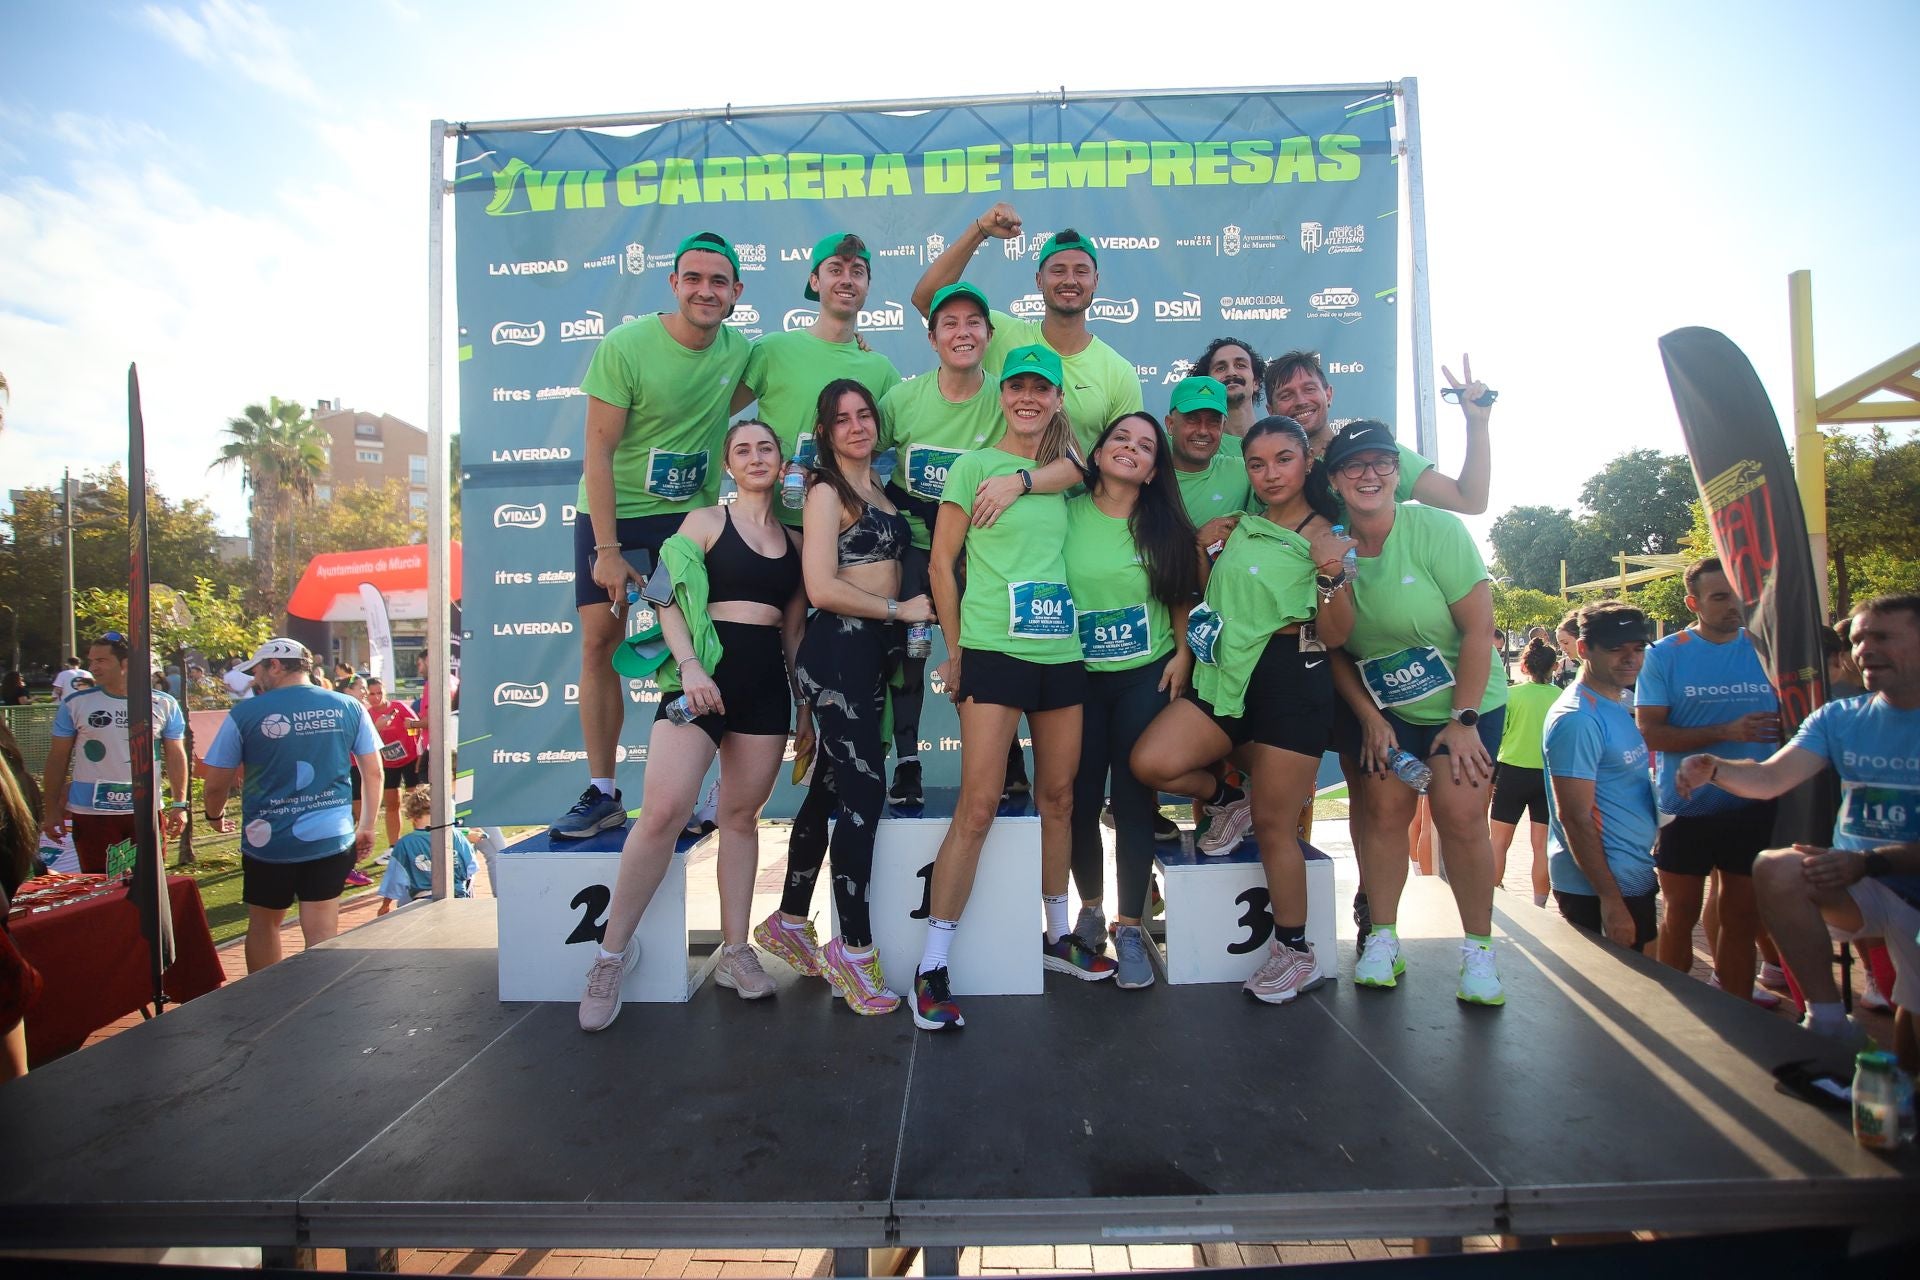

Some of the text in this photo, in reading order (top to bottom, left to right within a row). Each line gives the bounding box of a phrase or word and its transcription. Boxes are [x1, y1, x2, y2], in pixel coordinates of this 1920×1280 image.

[522, 134, 1361, 212] VII CARRERA DE EMPRESAS
[1100, 238, 1160, 249] VERDAD
[1323, 236, 1365, 245] ATLETISMO
[780, 248, 801, 261] LA
[490, 260, 568, 276] LA VERDAD
[1256, 296, 1286, 305] GLOBAL
[1094, 305, 1132, 316] VIDAL
[1154, 301, 1201, 317] DSM
[856, 310, 904, 327] DSM
[500, 328, 538, 340] VIDAL
[560, 319, 604, 338] DSM
[1329, 362, 1365, 374] Hero
[493, 388, 531, 402] itres
[492, 448, 571, 462] LA VERDAD
[667, 467, 697, 482] 814
[924, 465, 948, 482] 80
[501, 510, 540, 522] VIDAL
[316, 557, 422, 578] Ayuntamiento de Murcia
[495, 570, 576, 585] itres atalay
[1031, 600, 1062, 616] 804
[494, 622, 573, 636] LA VERDAD
[1095, 624, 1132, 642] 812
[1382, 661, 1425, 687] 806
[501, 689, 542, 700] VIDAL
[1683, 682, 1771, 697] Brocalsa
[292, 709, 343, 721] NIPPON
[295, 718, 336, 731] GASES
[493, 750, 531, 763] itres
[106, 792, 132, 800] 903
[565, 884, 611, 944] 2
[1227, 887, 1274, 954] 3
